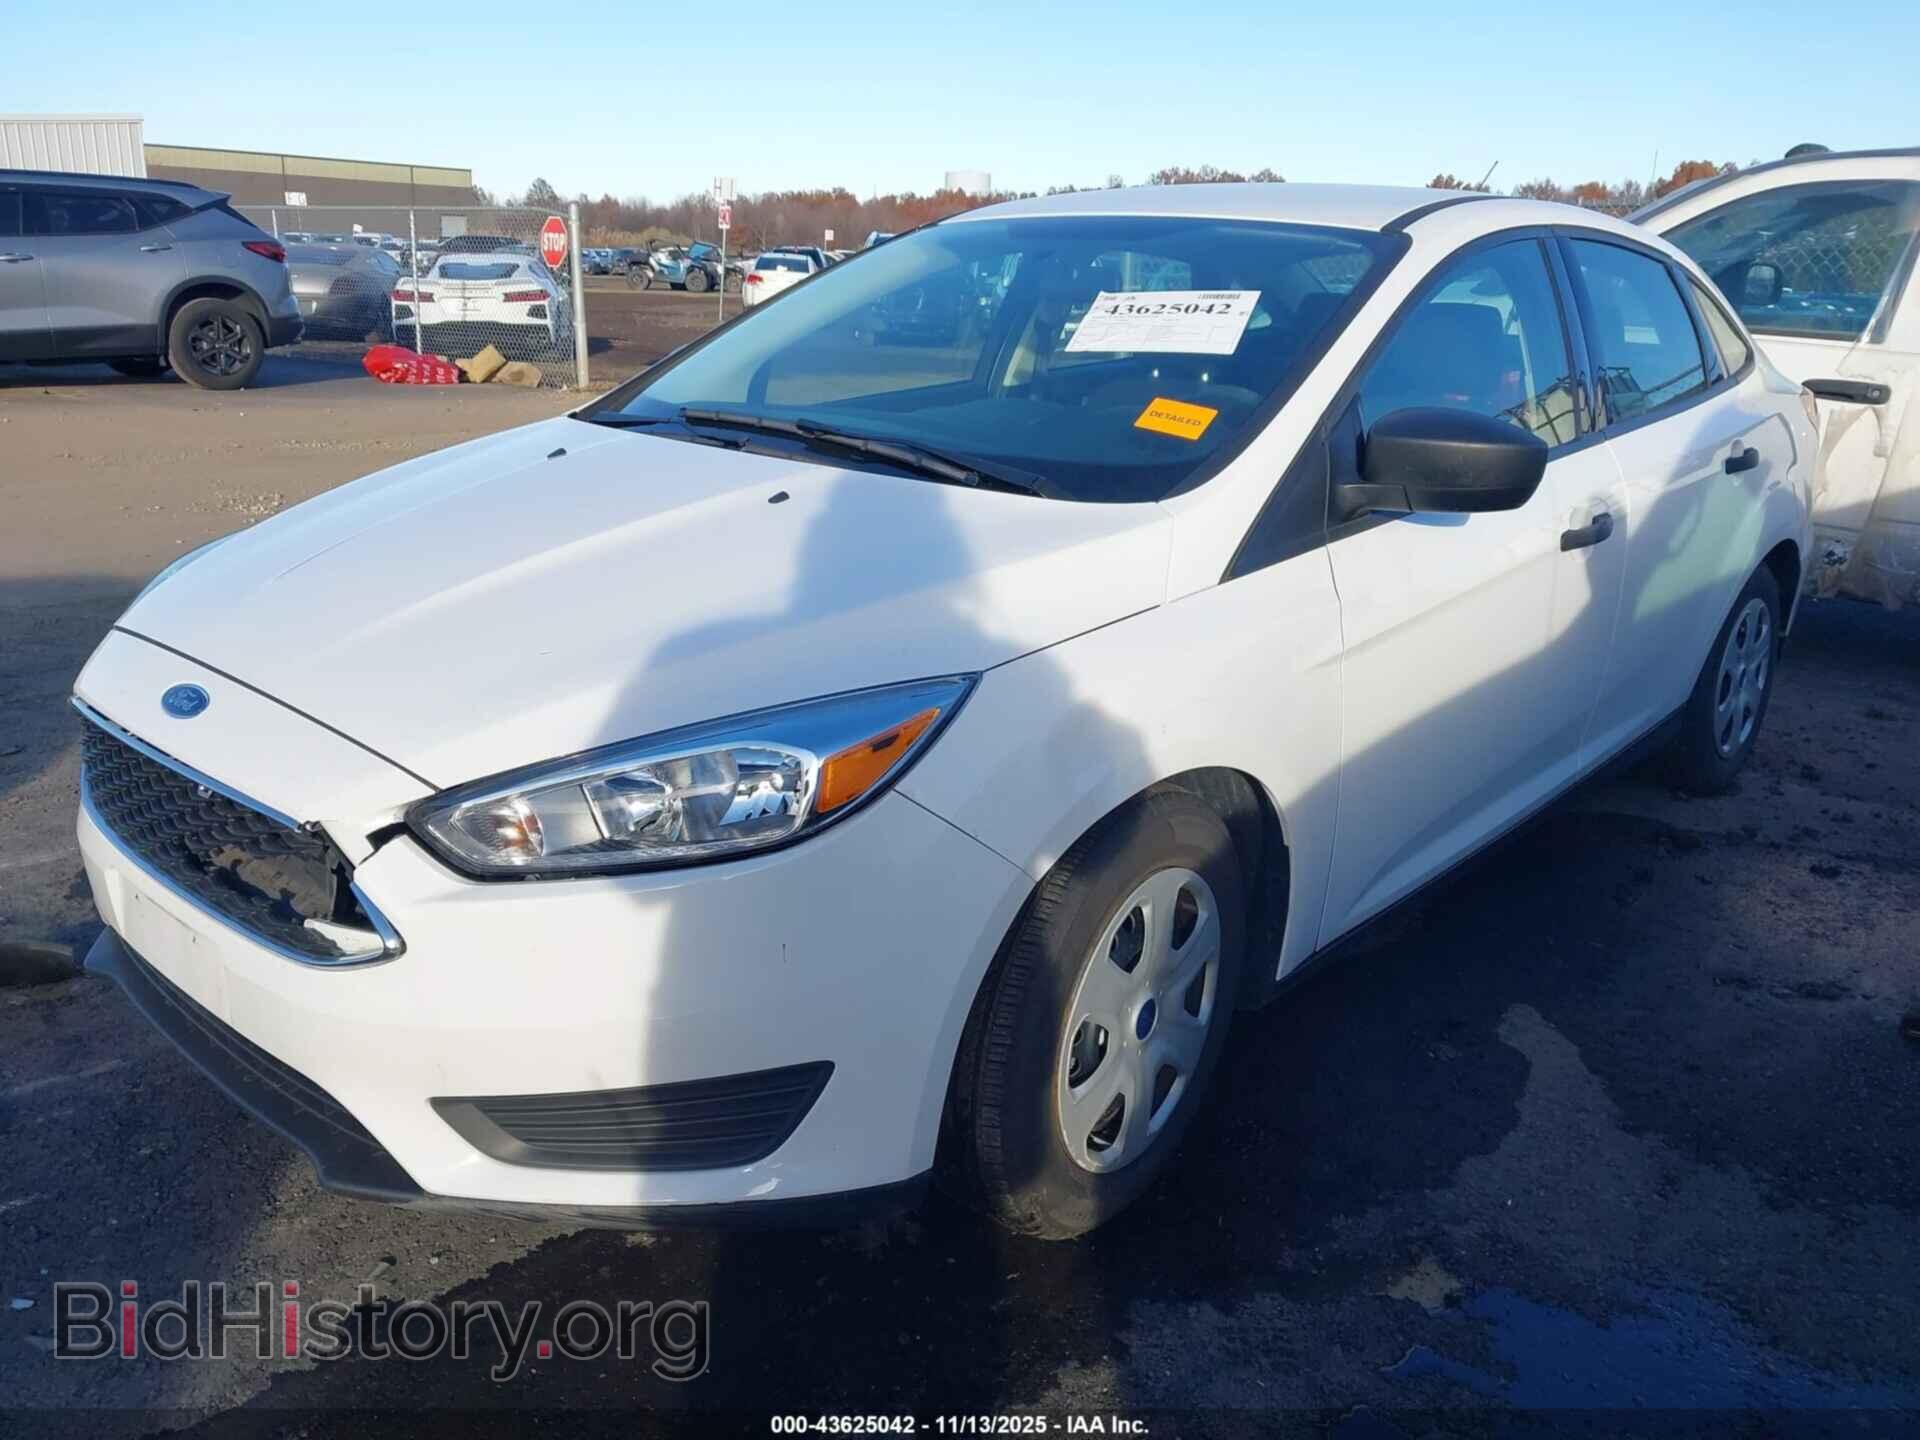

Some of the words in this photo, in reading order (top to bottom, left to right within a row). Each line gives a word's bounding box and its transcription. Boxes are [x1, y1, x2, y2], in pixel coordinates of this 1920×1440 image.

[543, 232, 565, 252] STOP
[1105, 303, 1232, 315] 43625042
[1150, 410, 1201, 426] DETAILED
